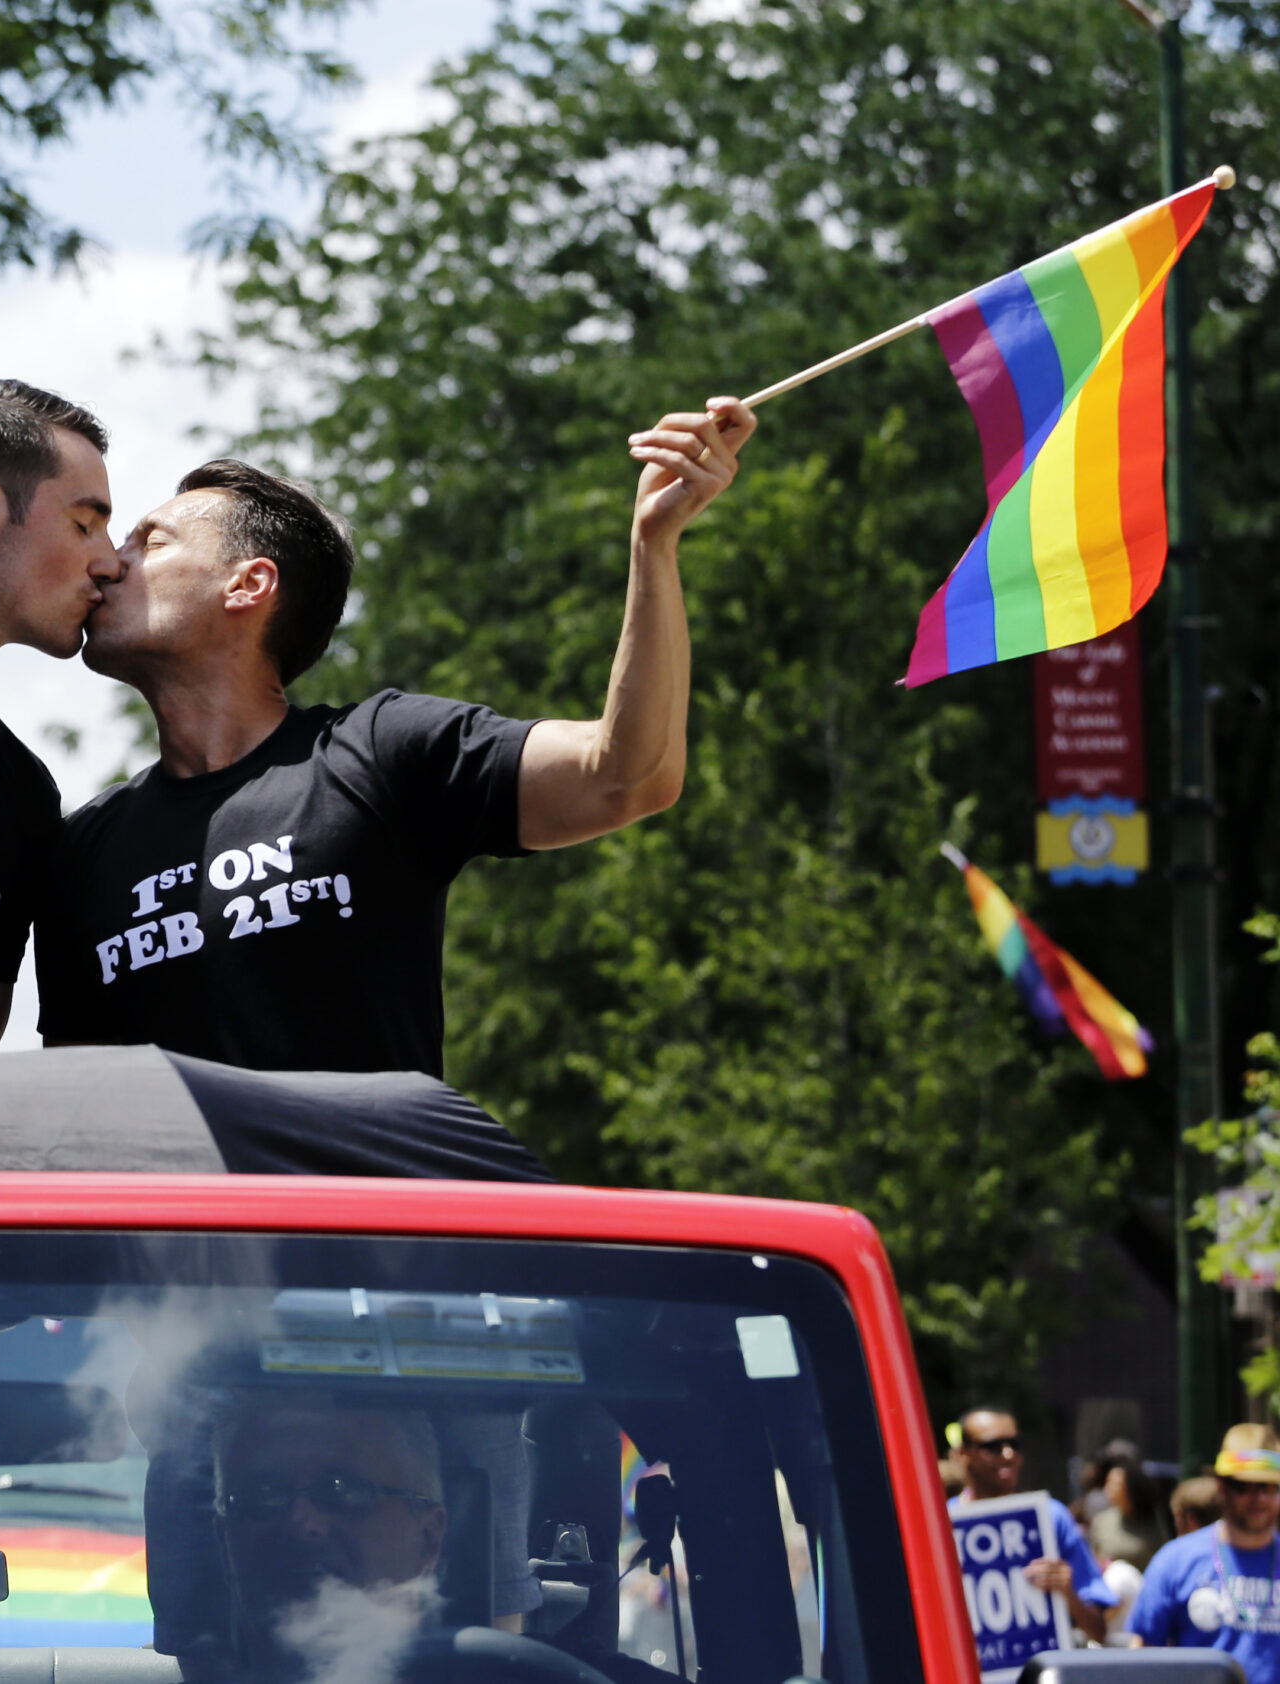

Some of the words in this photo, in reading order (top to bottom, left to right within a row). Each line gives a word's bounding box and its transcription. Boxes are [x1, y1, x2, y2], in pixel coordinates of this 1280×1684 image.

[131, 862, 197, 918] 1ST
[208, 834, 294, 891] ON
[96, 911, 205, 984] FEB
[222, 874, 353, 940] 21ST!
